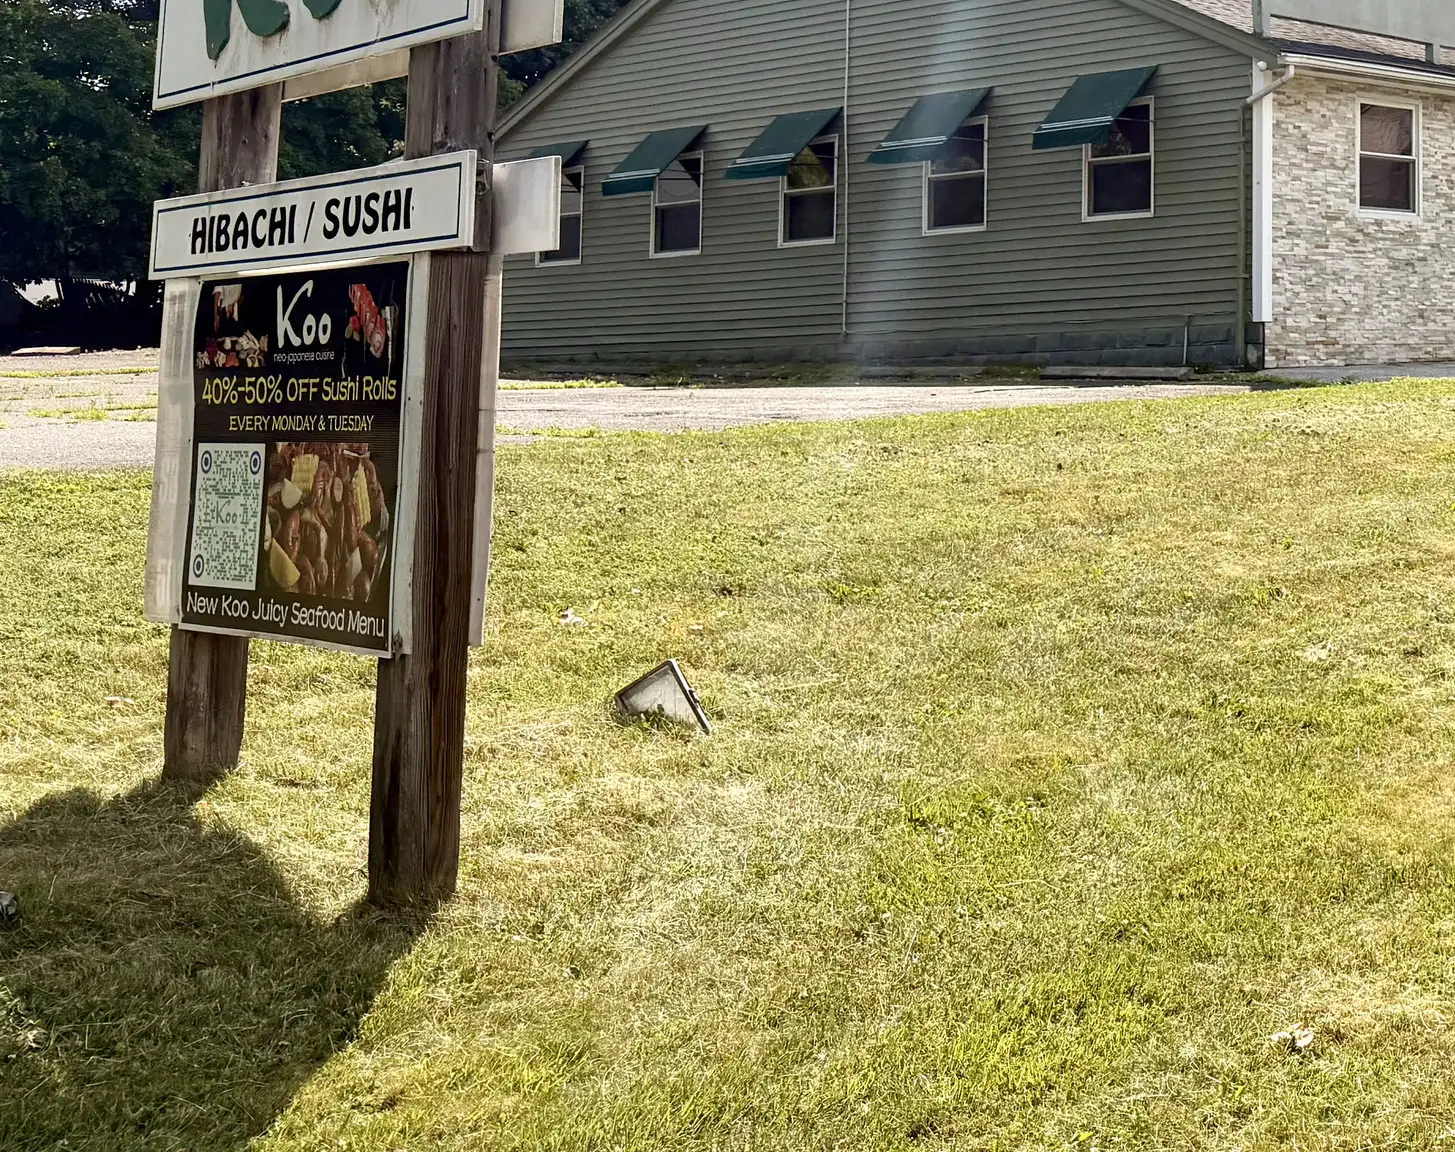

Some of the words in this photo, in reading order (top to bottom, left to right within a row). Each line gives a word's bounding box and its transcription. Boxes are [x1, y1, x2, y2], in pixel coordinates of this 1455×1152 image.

[190, 201, 297, 255] HIBACHI
[322, 187, 413, 240] SUSHI
[276, 279, 332, 349] Koo
[201, 374, 283, 405] 40%-50%
[286, 377, 320, 402] OFF
[321, 374, 360, 401] Sushi
[362, 375, 397, 401] Rolls
[229, 415, 271, 431] EVERY
[271, 415, 317, 431] MONDAY
[318, 415, 326, 431] &
[327, 415, 375, 431] TUESDAY
[216, 499, 238, 524] Koo
[186, 591, 218, 616] New
[221, 595, 249, 618] Koo
[252, 598, 289, 628] Juicy
[290, 602, 345, 632] Seafood
[347, 609, 385, 638] Menu
